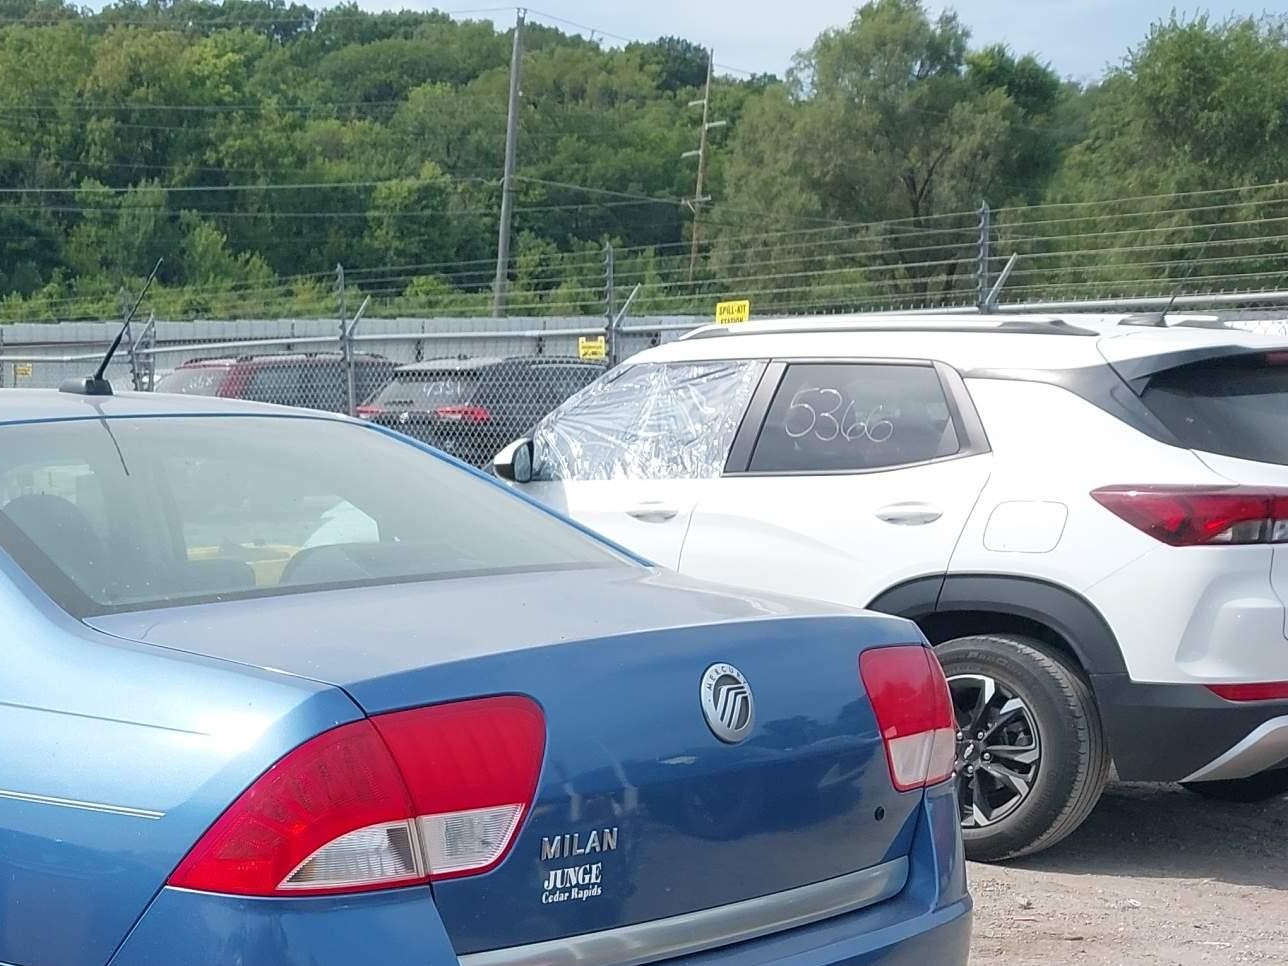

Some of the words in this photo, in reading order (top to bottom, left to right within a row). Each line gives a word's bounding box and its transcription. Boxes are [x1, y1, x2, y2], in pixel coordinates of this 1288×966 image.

[719, 304, 746, 316] SPILL-KIT
[785, 387, 894, 442] 5366
[540, 827, 619, 861] MILAN
[543, 862, 602, 891] JUNGE
[542, 890, 570, 904] Cedar
[571, 884, 602, 901] Rapids
